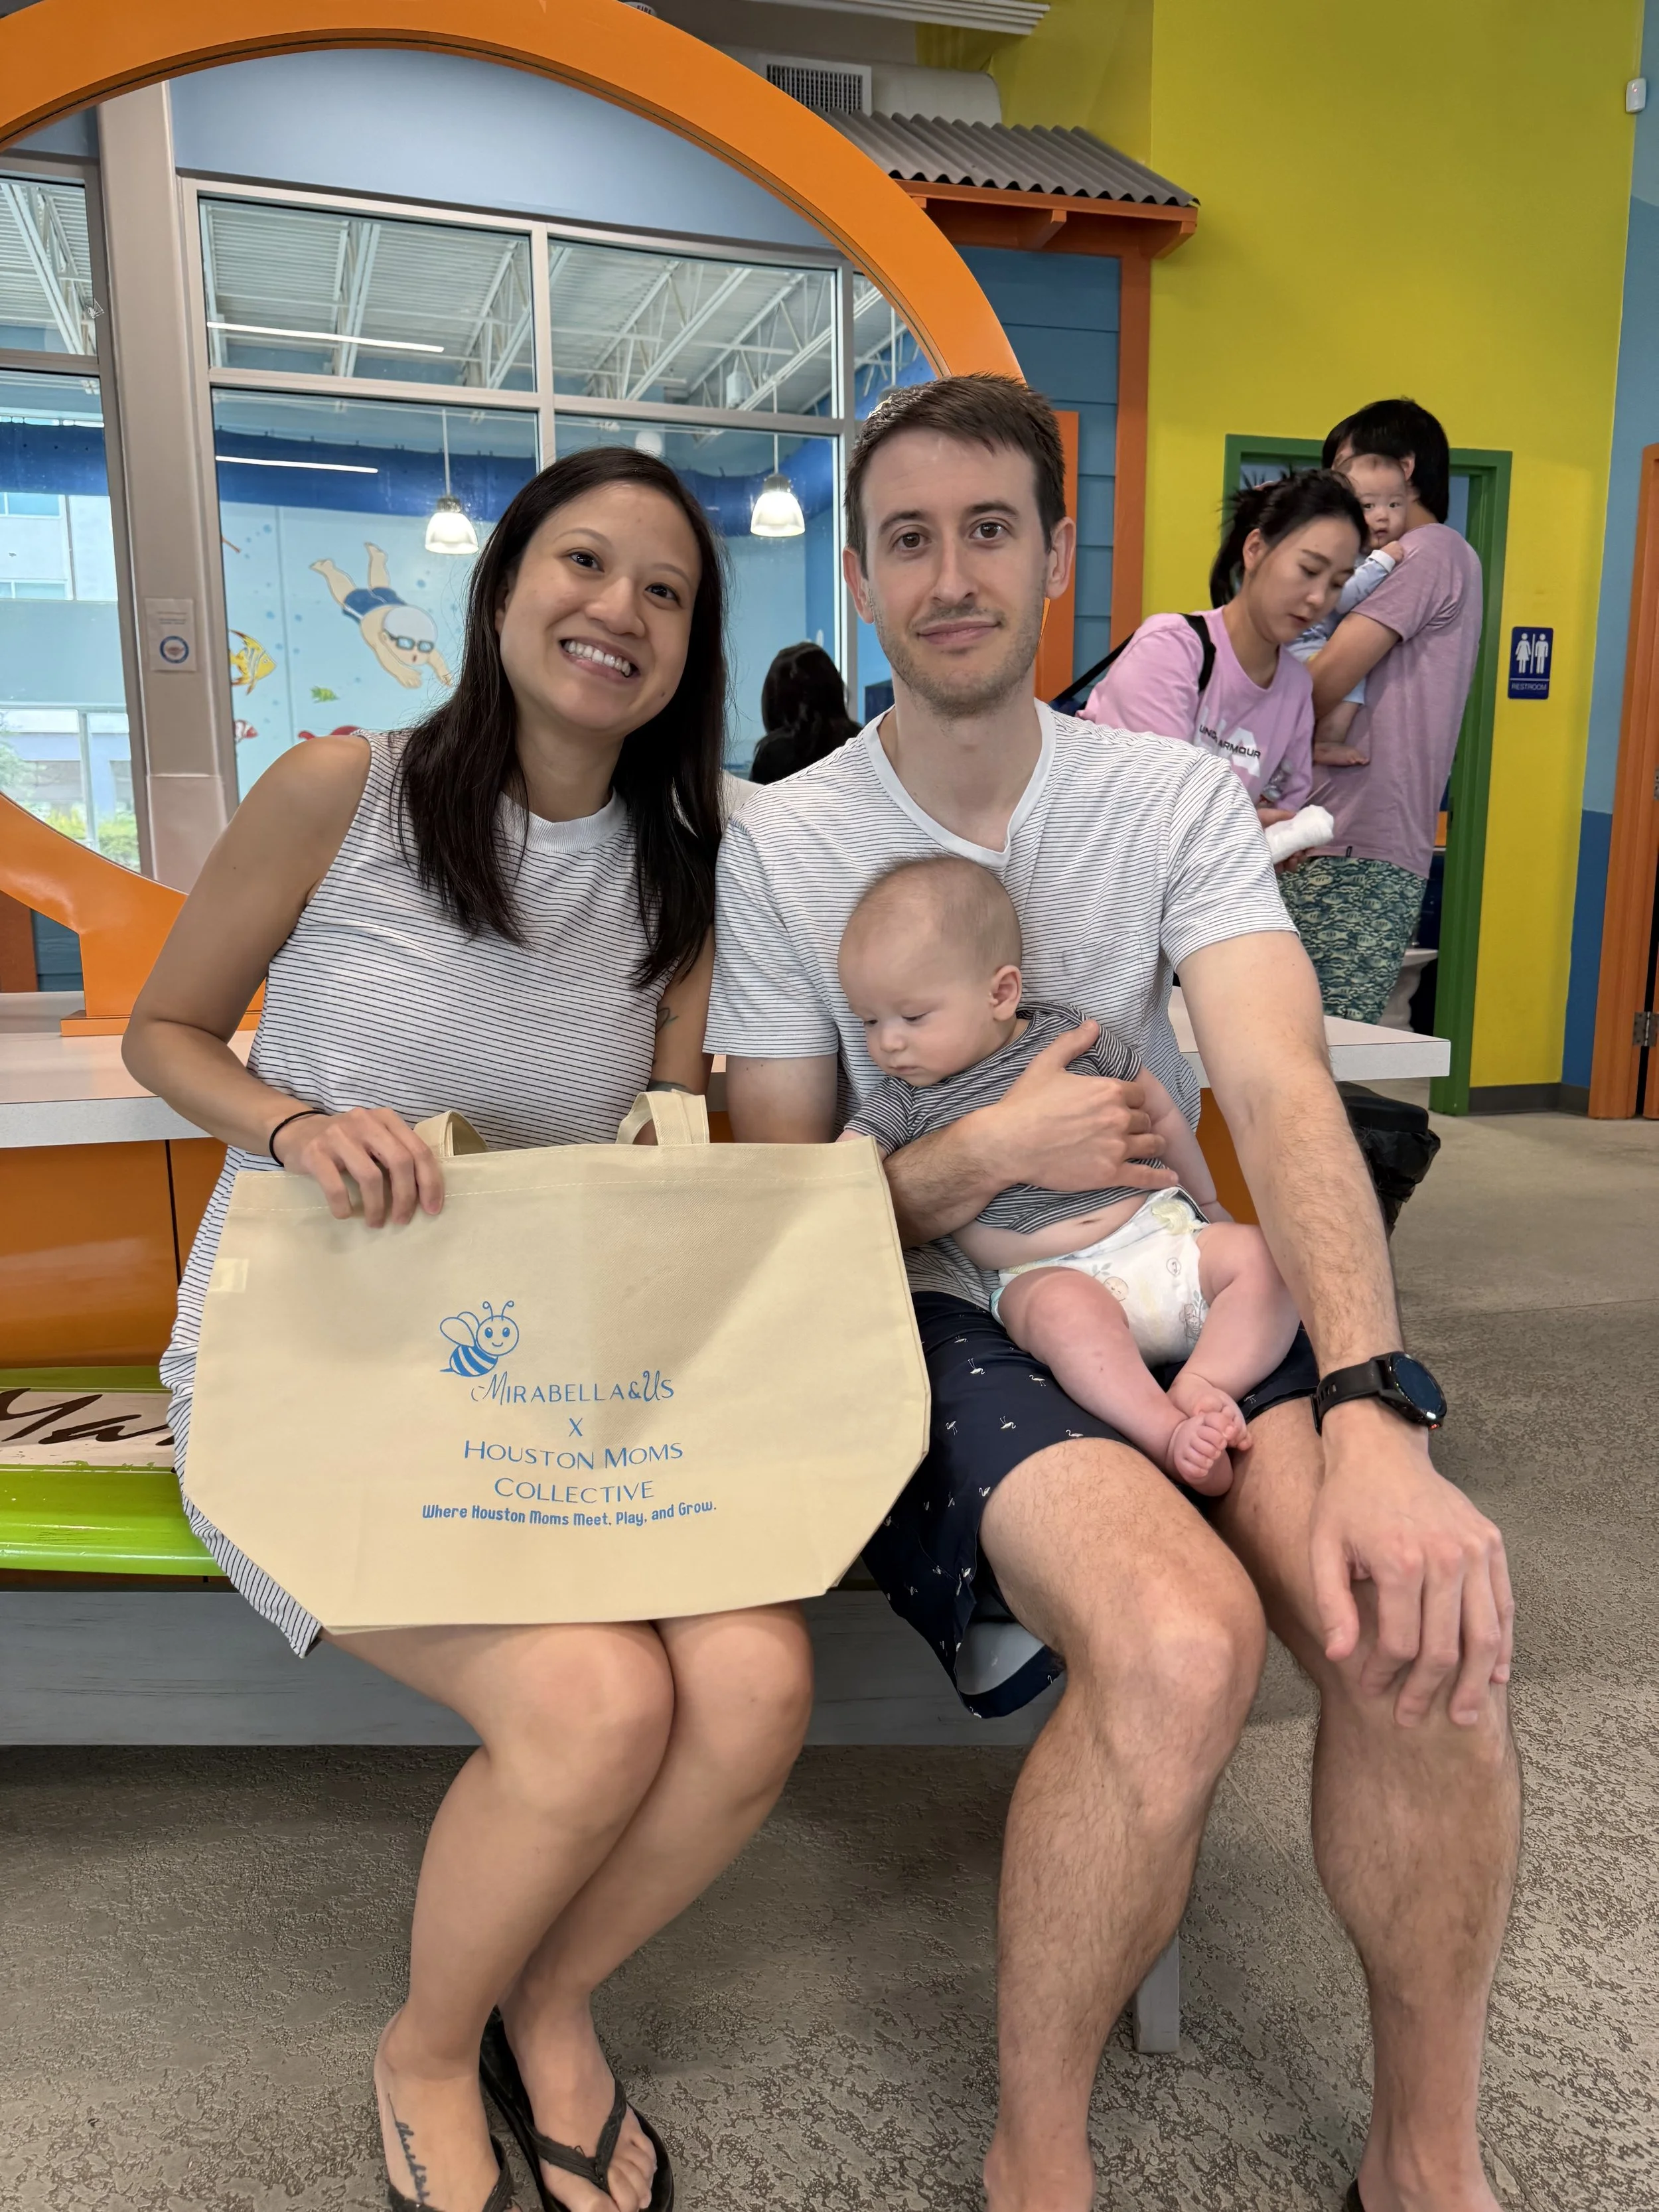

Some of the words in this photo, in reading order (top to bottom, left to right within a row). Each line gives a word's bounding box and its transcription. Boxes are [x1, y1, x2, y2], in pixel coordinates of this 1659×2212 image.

[465, 1440, 594, 1470] HOUSTON
[605, 1443, 684, 1469] MOMS
[494, 1477, 654, 1504] COLLECTIVE
[422, 1505, 468, 1519] Where
[471, 1505, 526, 1523] Houston
[529, 1510, 569, 1526] Moms
[616, 1511, 648, 1527] Play,
[651, 1504, 675, 1521] and
[678, 1501, 717, 1516] Grow.
